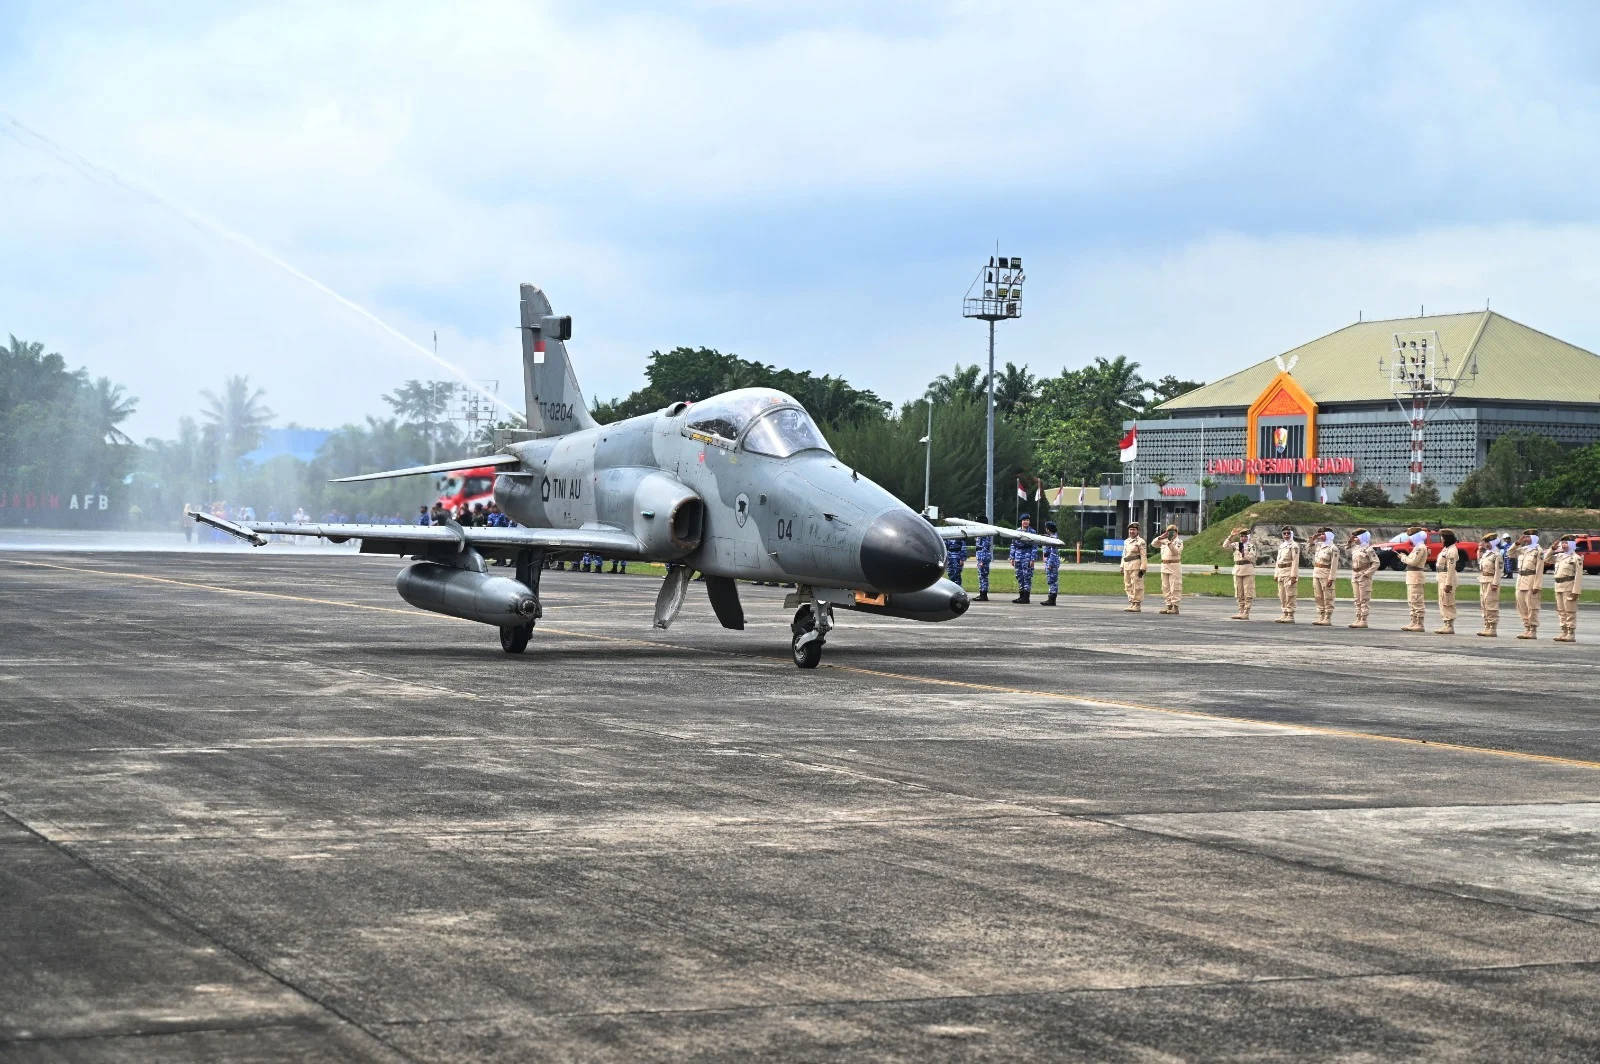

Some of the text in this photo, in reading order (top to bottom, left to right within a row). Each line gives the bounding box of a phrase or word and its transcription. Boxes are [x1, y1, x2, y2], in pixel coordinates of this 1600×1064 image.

[538, 401, 574, 422] TT-0204
[1208, 457, 1355, 475] LANUD ROESMIN NURJADIN
[554, 478, 581, 499] TNI AU
[69, 494, 109, 510] AFB
[777, 518, 793, 541] 04
